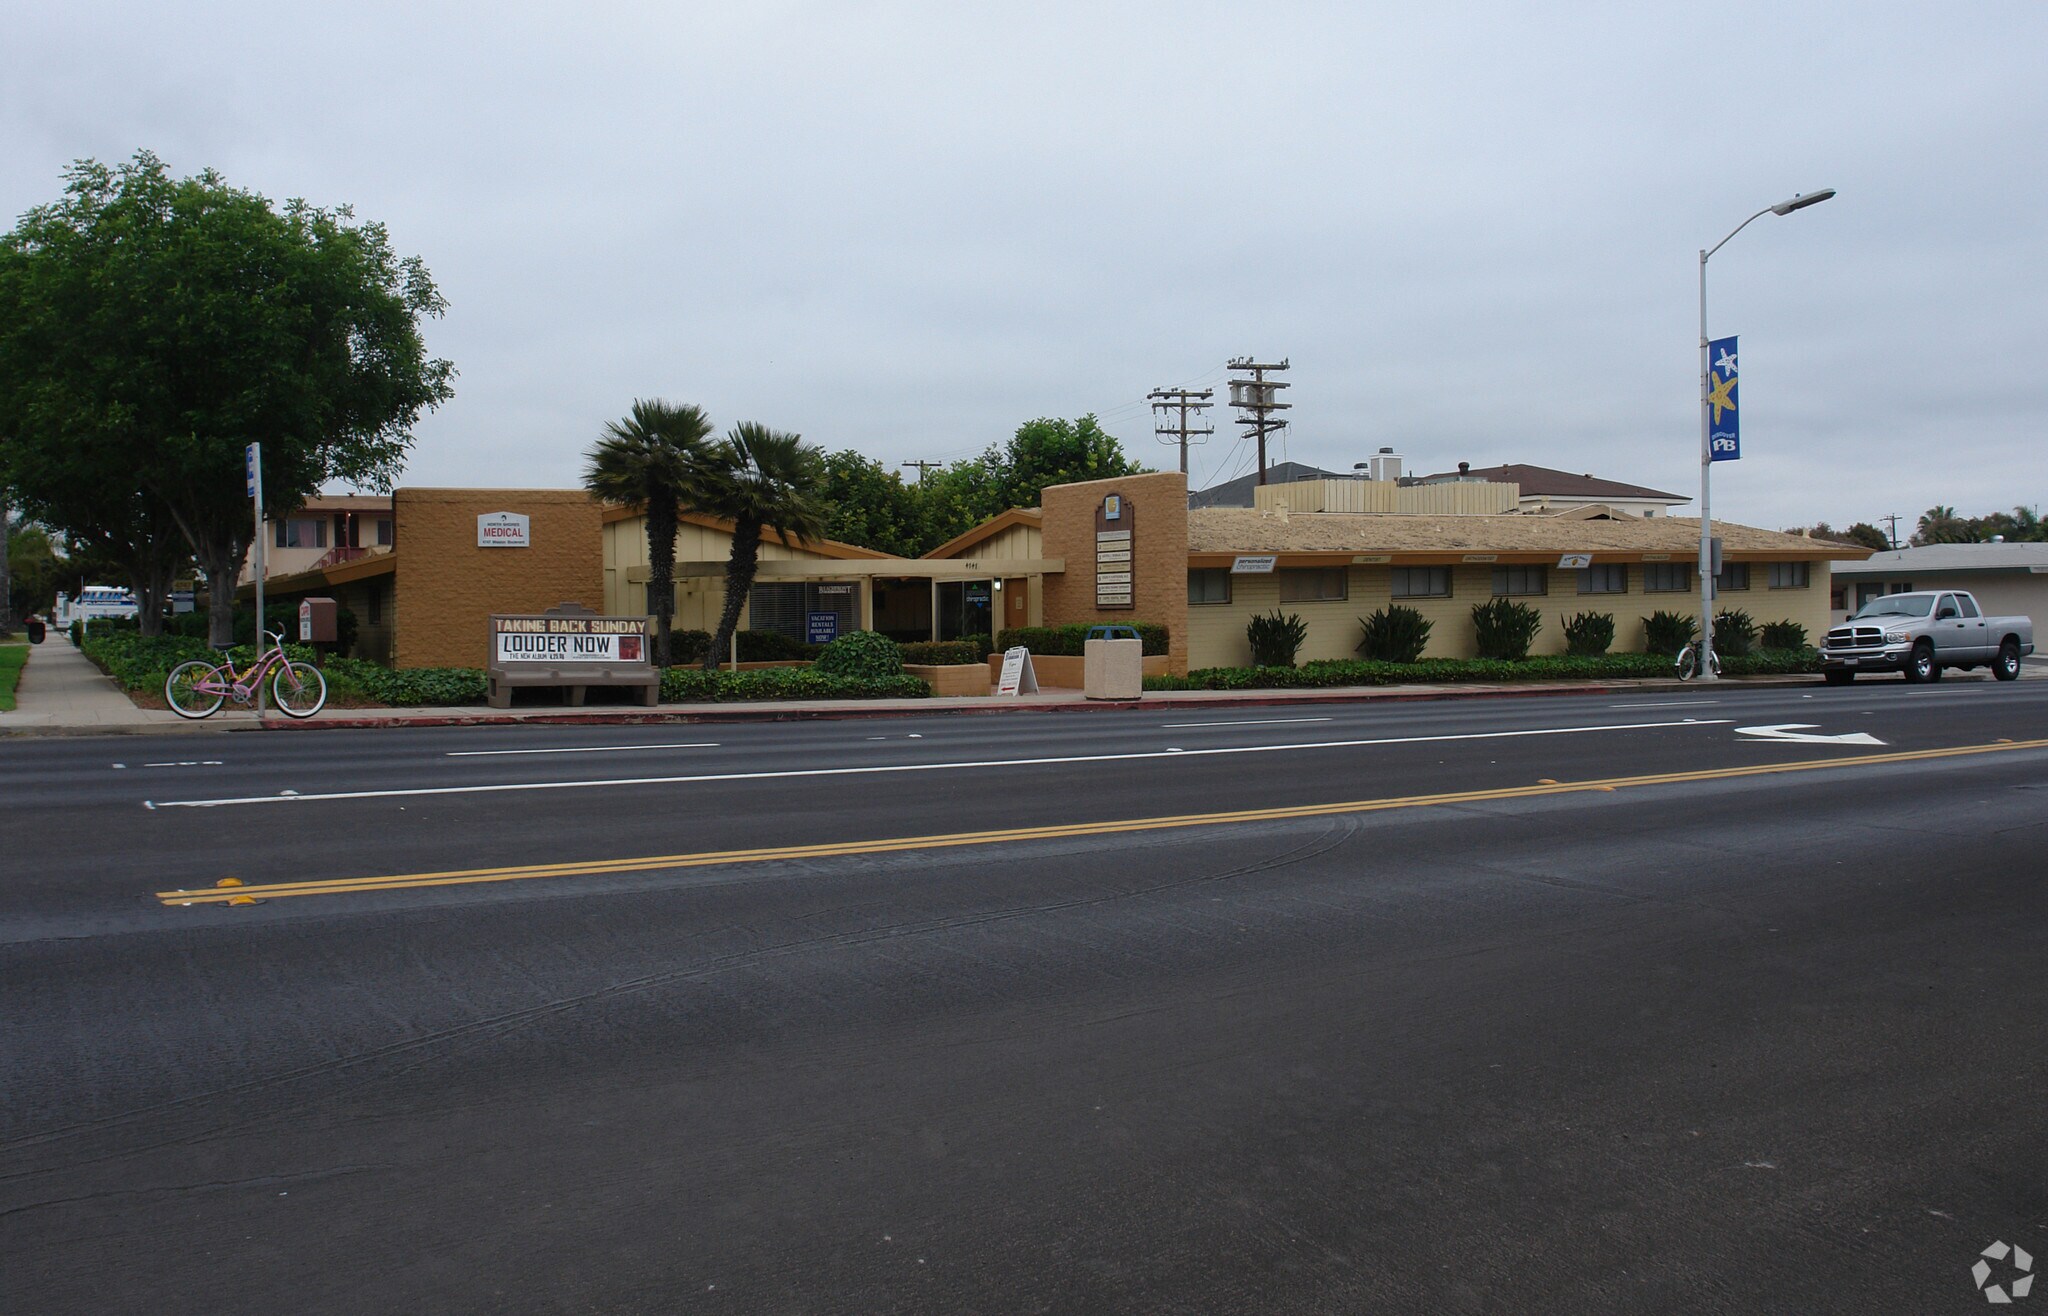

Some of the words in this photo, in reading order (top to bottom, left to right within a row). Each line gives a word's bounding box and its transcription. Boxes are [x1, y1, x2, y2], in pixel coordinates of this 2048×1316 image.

[1713, 438, 1736, 451] PB
[483, 527, 524, 538] MEDICAL
[1236, 563, 1271, 571] chiropractic
[1238, 557, 1273, 565] personalized
[496, 619, 546, 632] TAKING
[550, 619, 588, 633] BACK
[591, 620, 645, 633] SUNDAY
[504, 635, 567, 653] LOUDER
[573, 636, 610, 653] NOW
